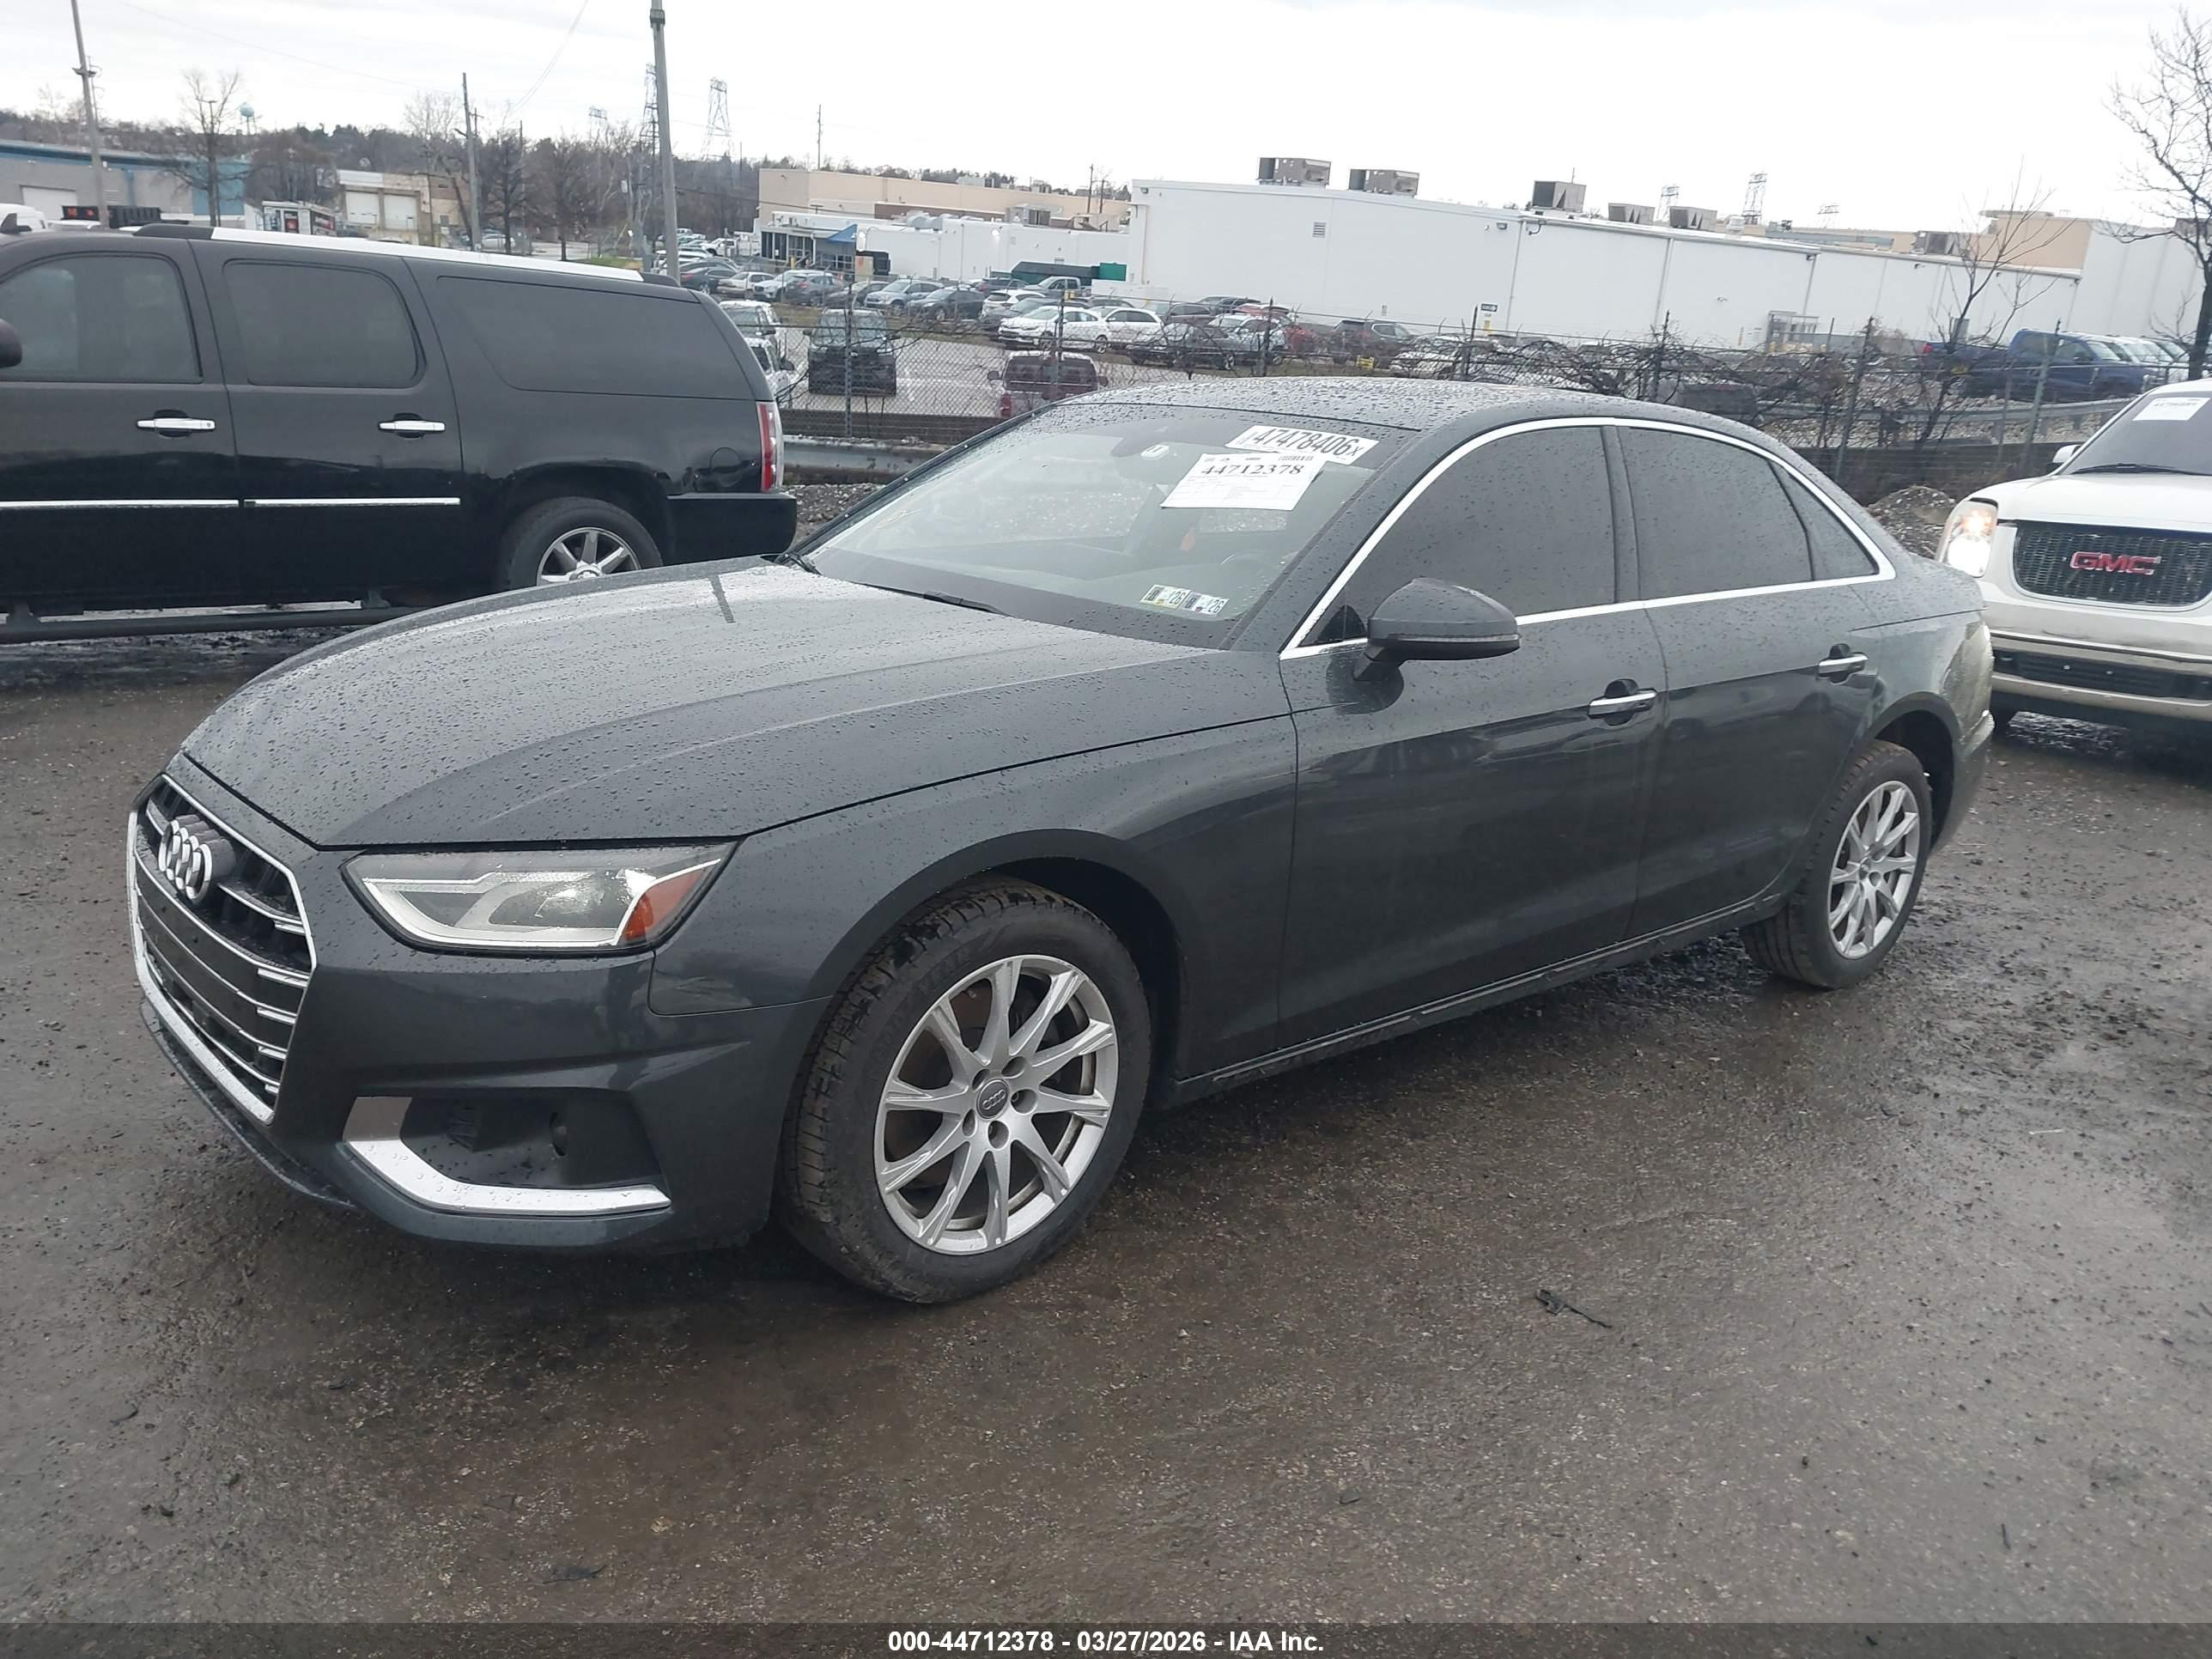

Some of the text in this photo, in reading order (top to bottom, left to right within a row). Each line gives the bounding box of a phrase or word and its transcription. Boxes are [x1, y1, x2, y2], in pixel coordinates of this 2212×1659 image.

[1253, 428, 1359, 456] 47478406
[1201, 465, 1304, 475] 44712378
[2069, 550, 2162, 575] GMC
[1207, 599, 1224, 614] 26
